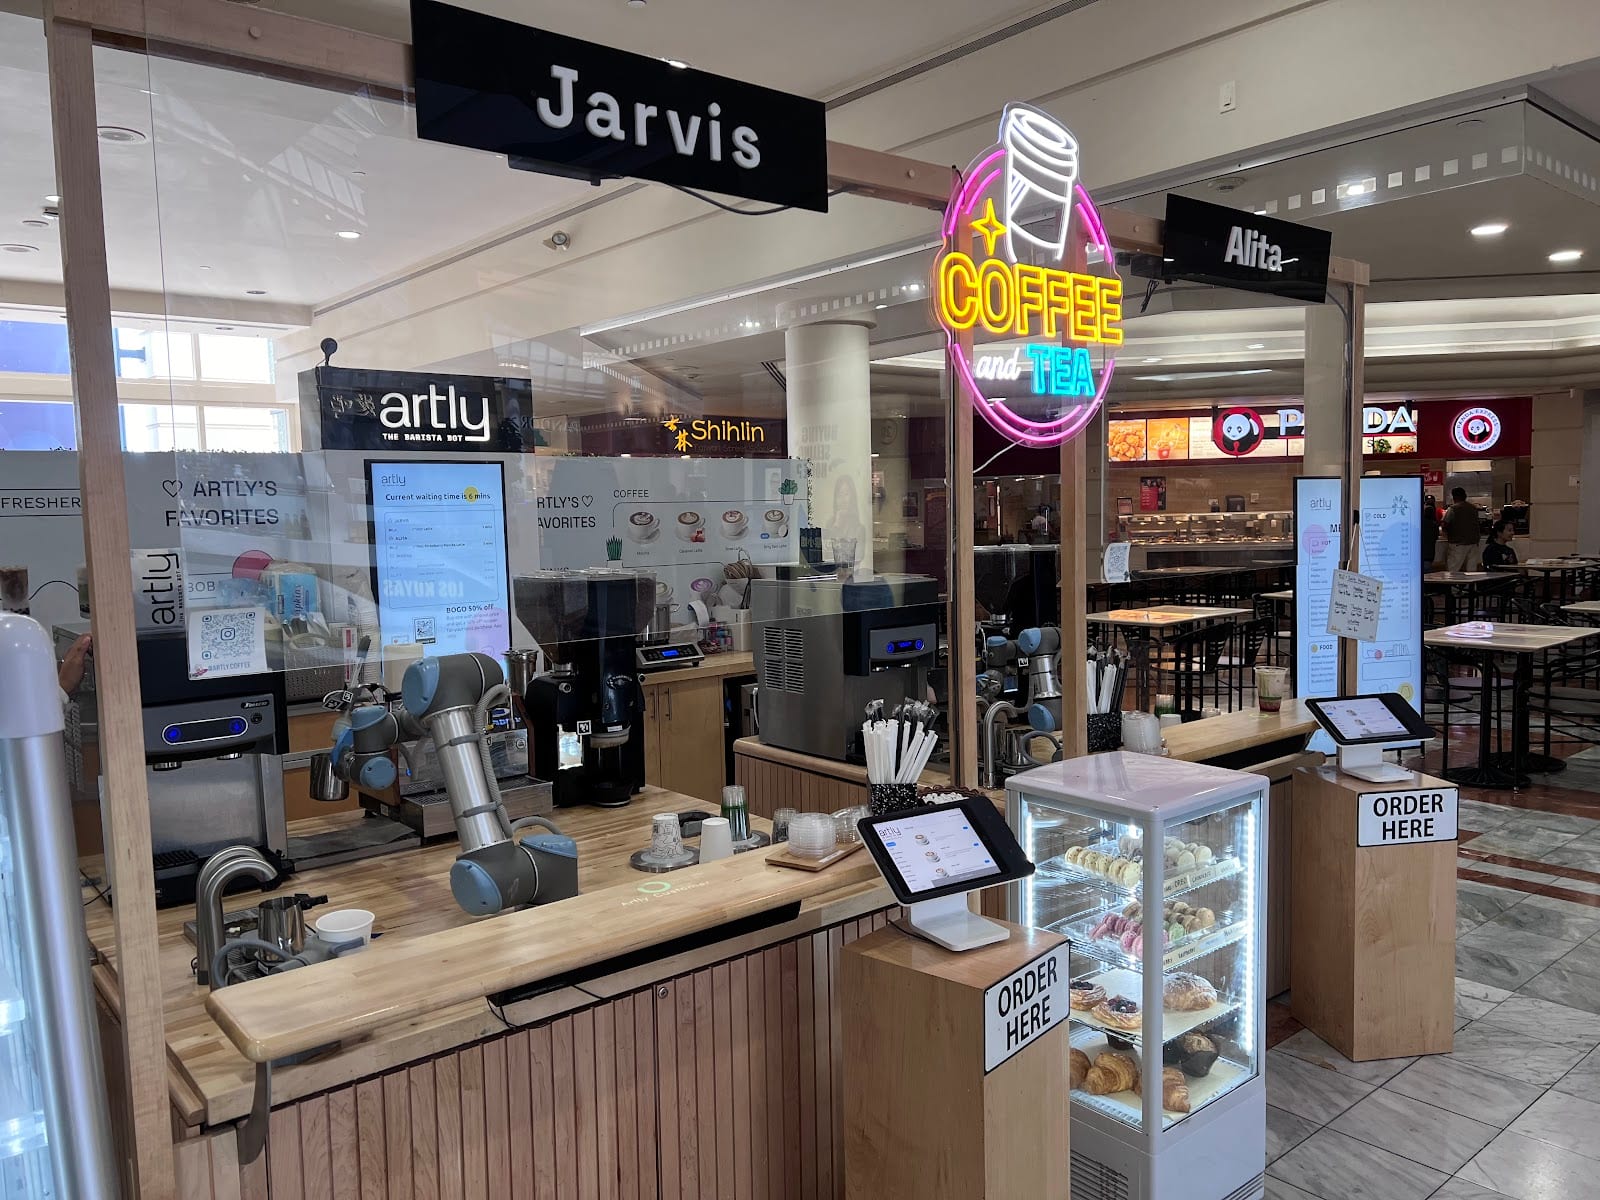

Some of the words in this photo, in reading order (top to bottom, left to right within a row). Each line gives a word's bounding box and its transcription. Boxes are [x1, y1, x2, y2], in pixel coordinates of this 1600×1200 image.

[536, 64, 761, 169] Jarvis
[1224, 226, 1282, 272] Alita
[940, 252, 1123, 344] COFFEE
[975, 347, 1020, 380] and
[1026, 343, 1096, 396] TEA
[379, 384, 491, 442] artly
[691, 420, 764, 442] Shihlin
[193, 480, 278, 497] ARTLY'S
[381, 474, 406, 487] artly
[385, 493, 414, 501] Current
[415, 493, 442, 502] waiting
[443, 492, 460, 500] time
[461, 492, 467, 500] is
[474, 492, 491, 500] mins
[613, 489, 649, 499] COFFEE
[165, 509, 279, 527] FAVORITES
[142, 553, 179, 625] artly
[468, 604, 482, 612] 50%
[1373, 793, 1444, 817] ORDER
[1382, 818, 1434, 841] HERE
[998, 956, 1058, 1018] ORDER
[1006, 995, 1051, 1051] HERE
